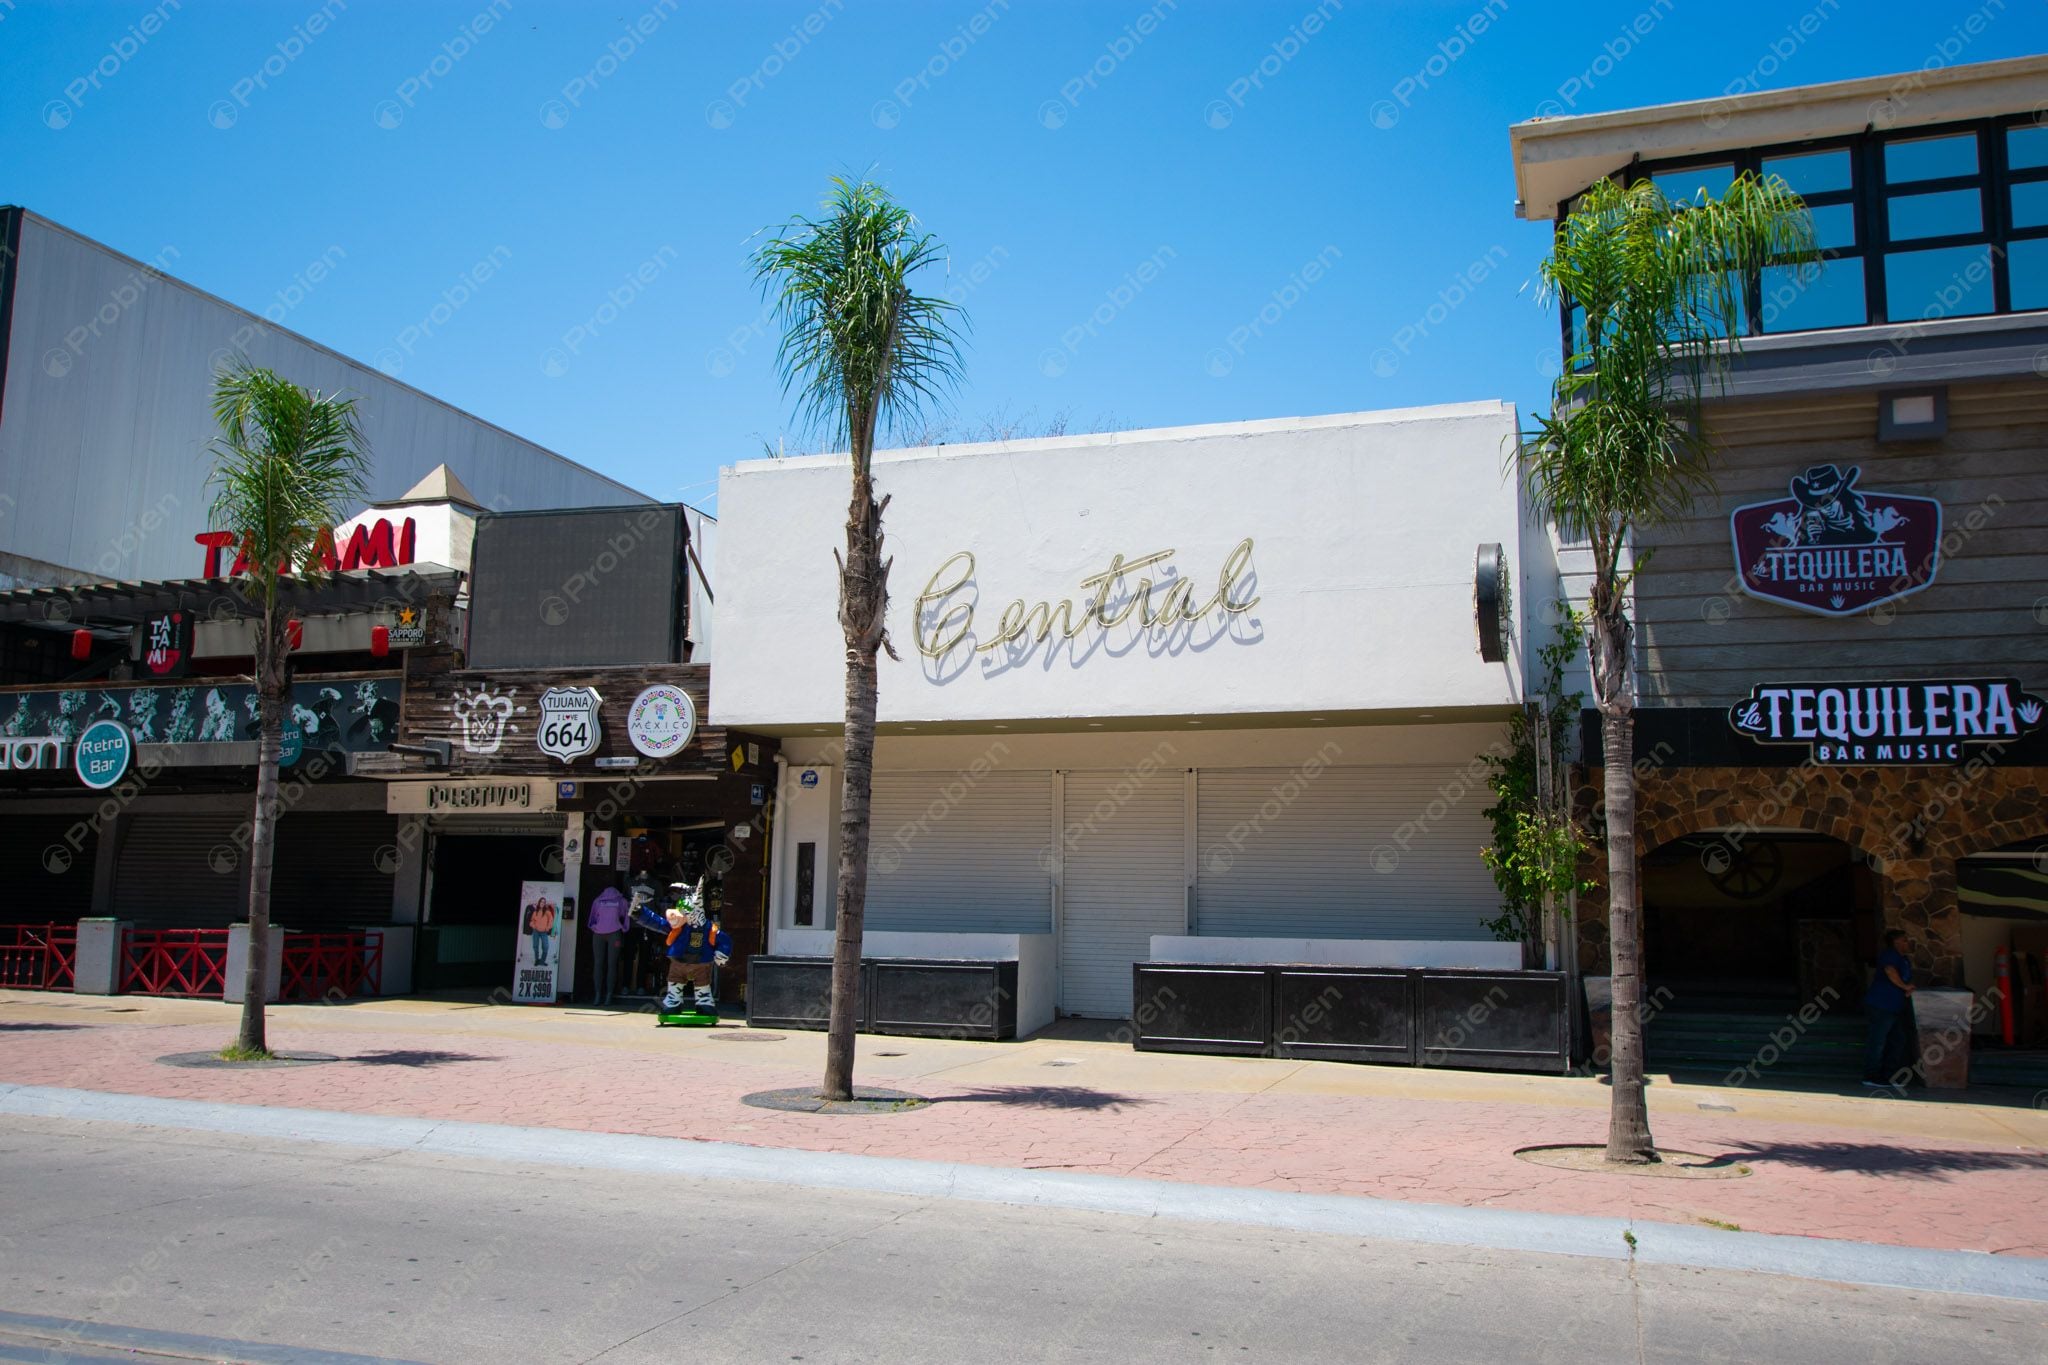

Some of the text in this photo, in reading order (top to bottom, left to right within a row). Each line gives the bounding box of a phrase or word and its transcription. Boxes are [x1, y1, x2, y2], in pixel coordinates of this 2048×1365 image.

[1766, 548, 1909, 582] TEQUILERA
[1800, 581, 1876, 593] BAR MUSIC
[913, 537, 1261, 657] Central
[548, 697, 589, 708] TIJUANA
[1737, 684, 2019, 742] La TEQUILERA
[631, 720, 689, 730] MÉXICO
[545, 722, 587, 747] 664
[82, 738, 123, 755] Retro
[1820, 743, 1958, 760] BAR MUSIC
[90, 759, 115, 774] Bar
